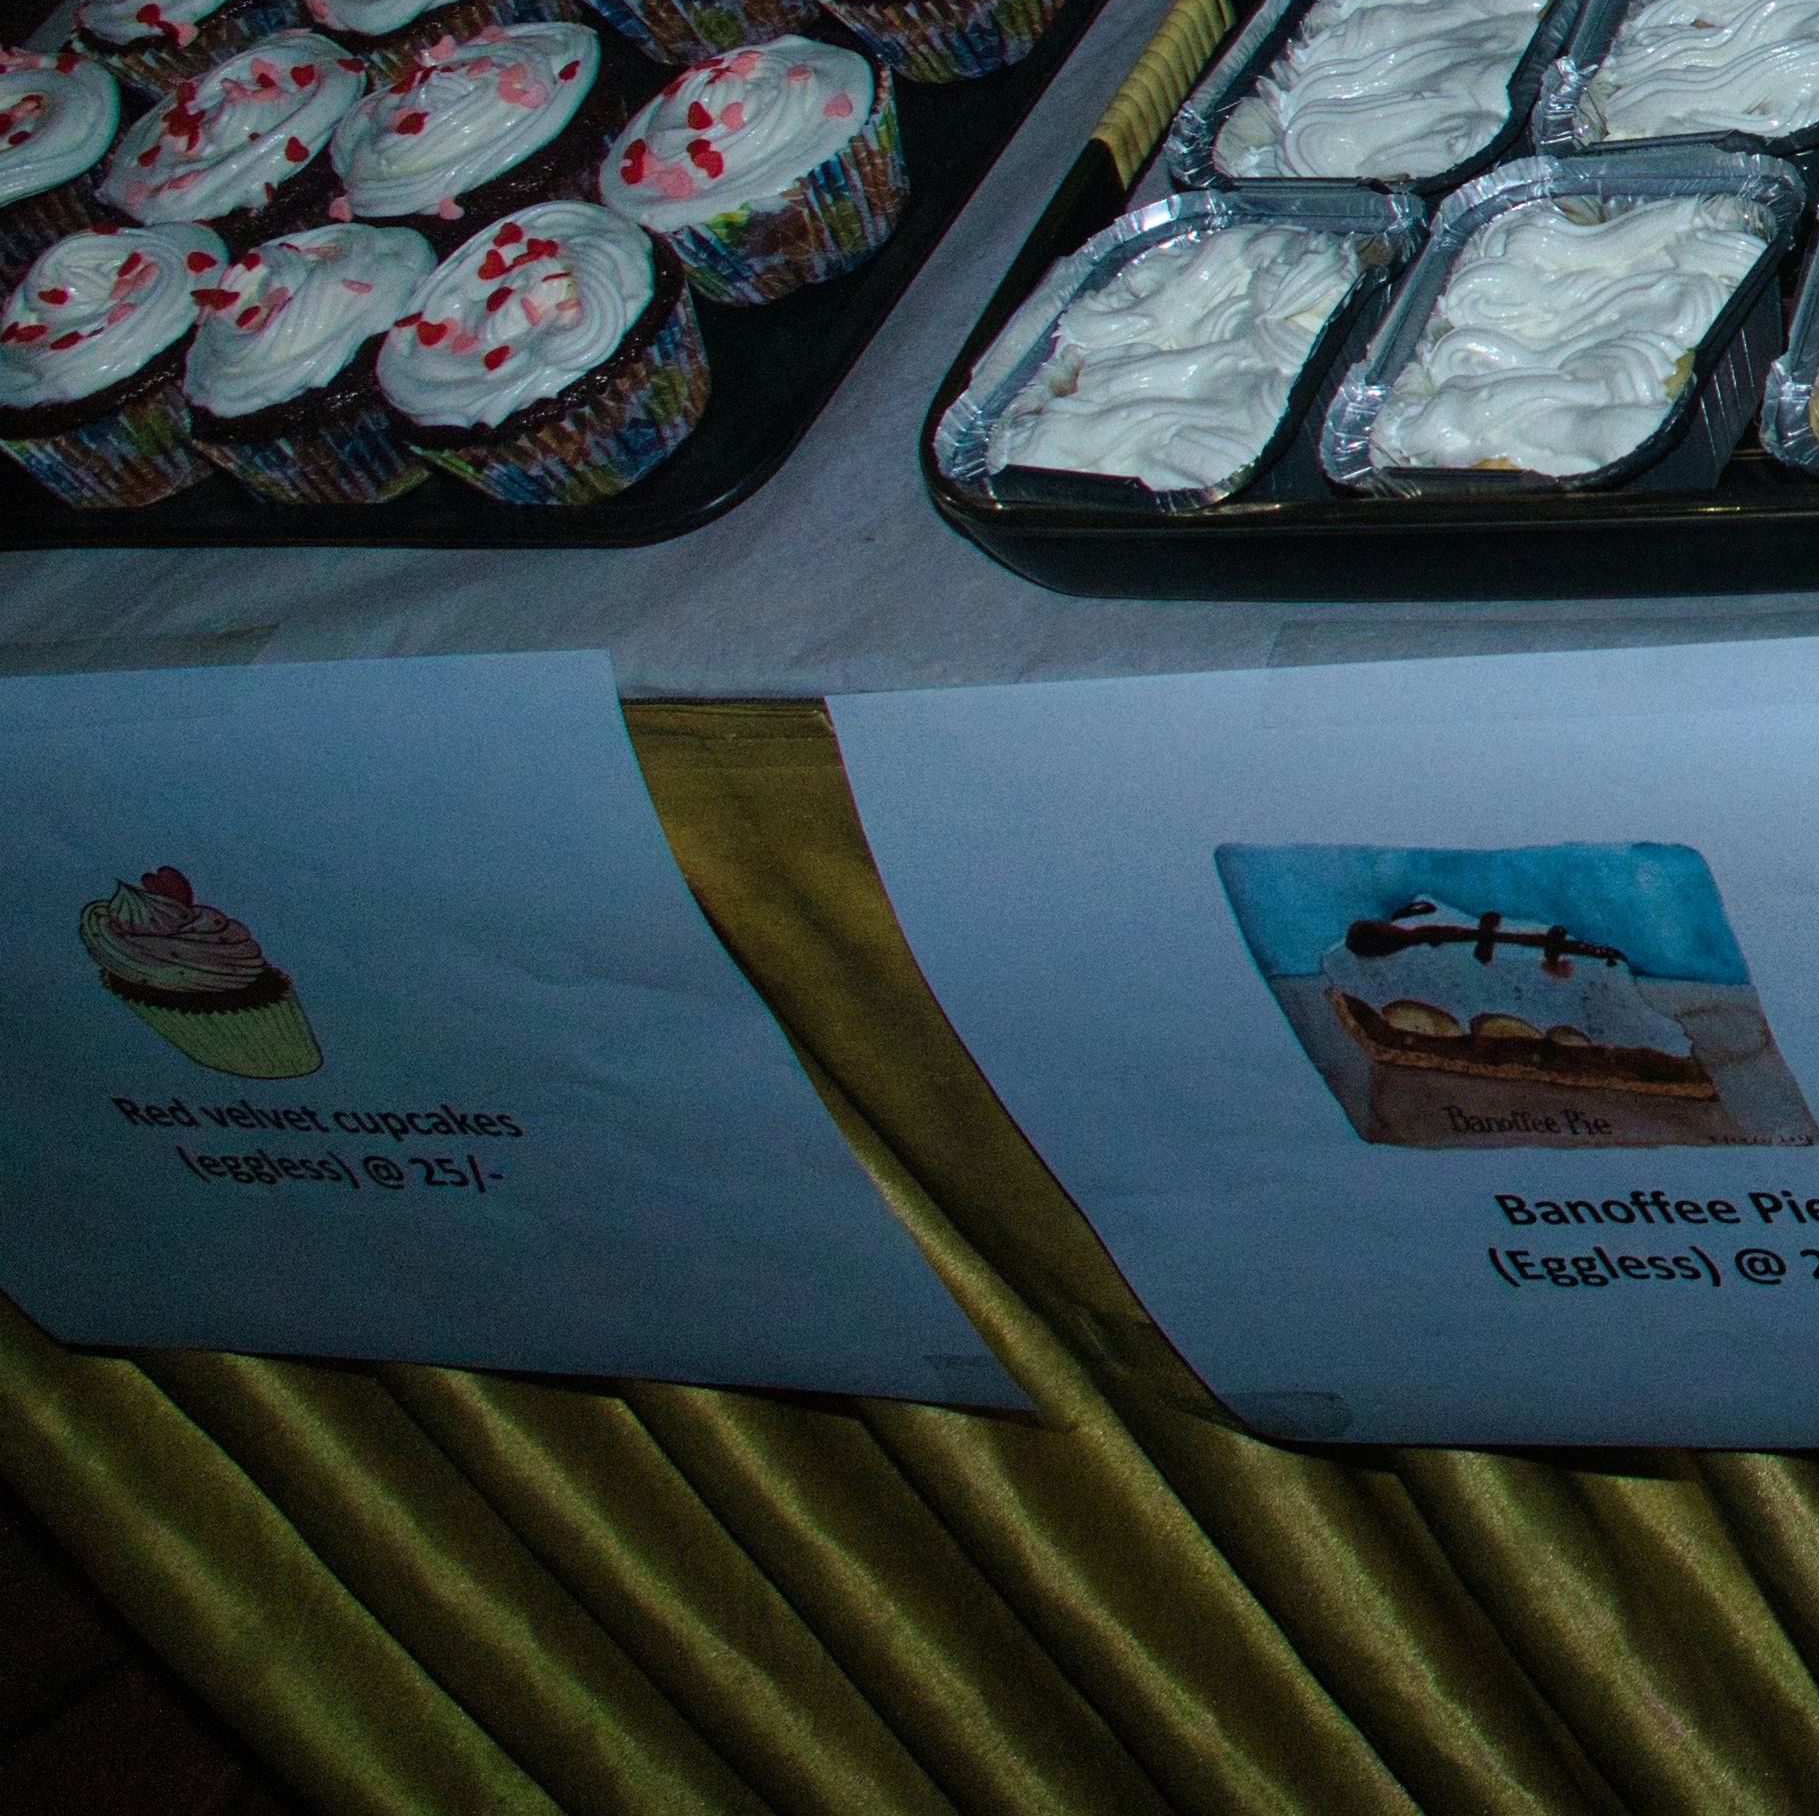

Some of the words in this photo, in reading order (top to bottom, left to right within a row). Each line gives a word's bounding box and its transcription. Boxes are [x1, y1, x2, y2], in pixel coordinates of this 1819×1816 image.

[111, 1097, 197, 1127] Red
[201, 1100, 328, 1133] velvet
[332, 1106, 524, 1142] cupcakes
[1444, 1106, 1560, 1136] Banoffee
[1565, 1108, 1612, 1137] Pie
[176, 1146, 360, 1189] (eggless)
[365, 1156, 405, 1189] @
[418, 1156, 503, 1192] 25/-
[1495, 1191, 1740, 1226] Banoffee
[1488, 1247, 1721, 1286] (Eggless)
[1734, 1248, 1788, 1284] @
